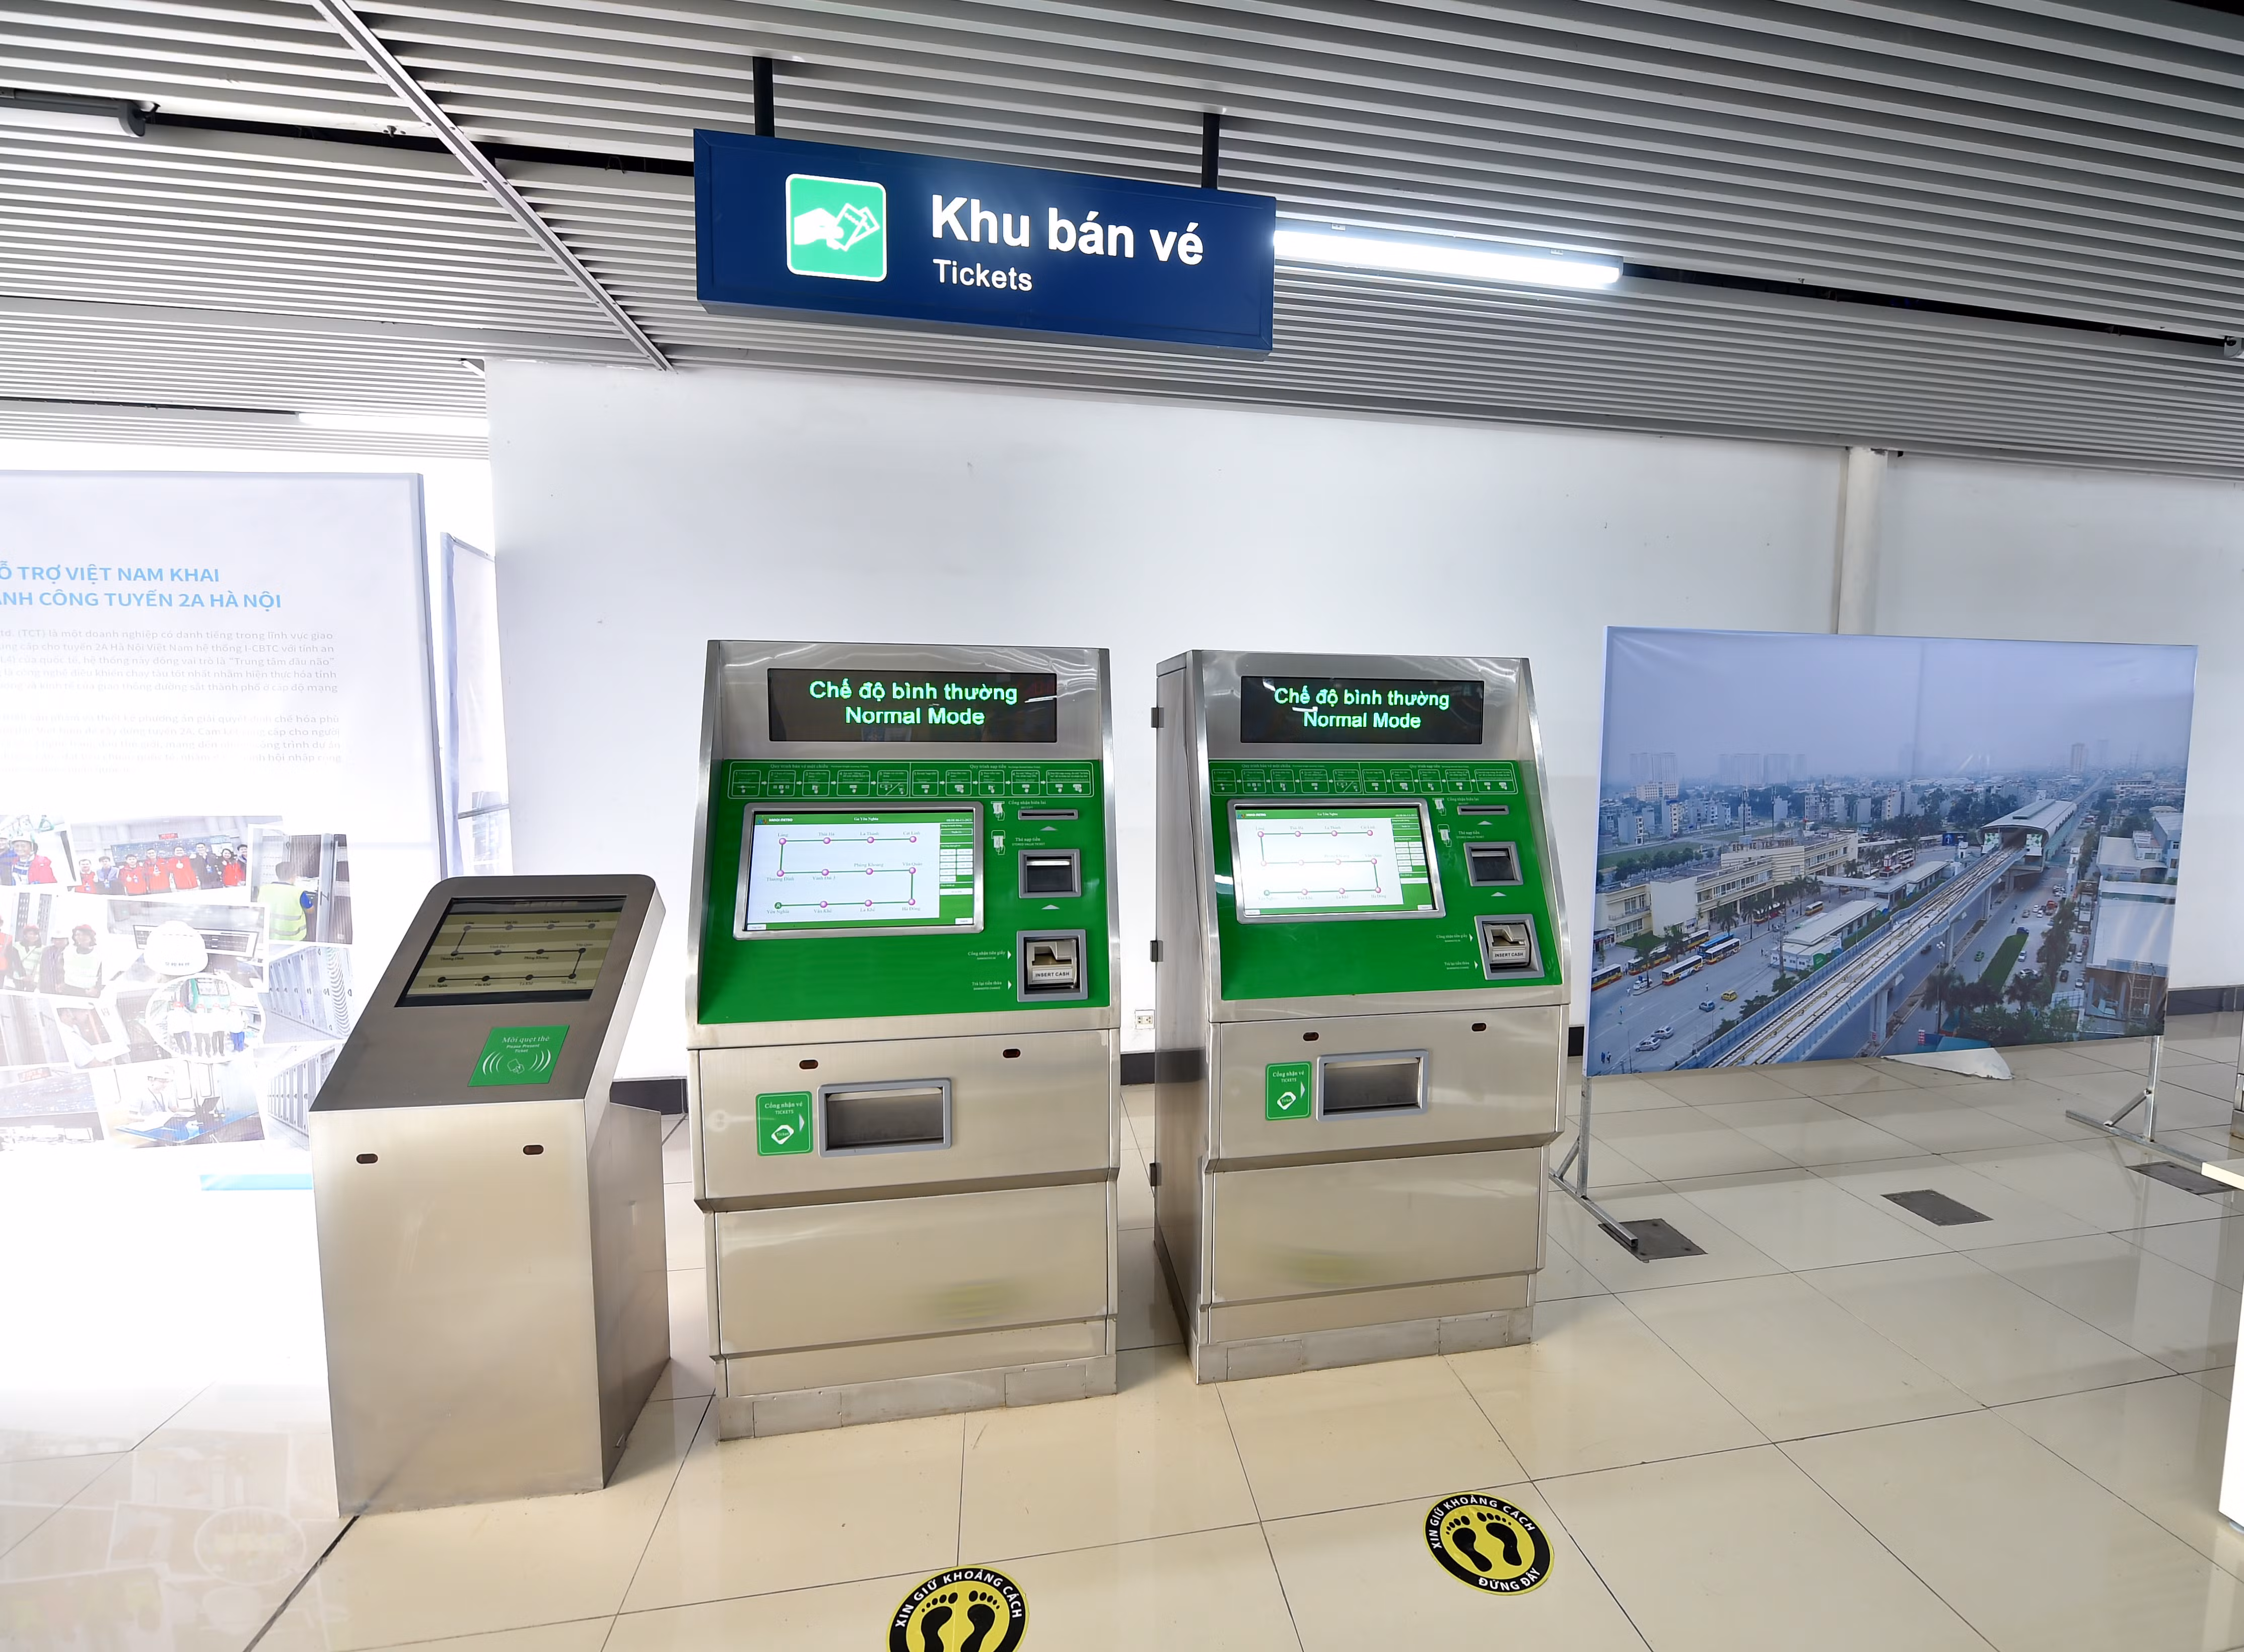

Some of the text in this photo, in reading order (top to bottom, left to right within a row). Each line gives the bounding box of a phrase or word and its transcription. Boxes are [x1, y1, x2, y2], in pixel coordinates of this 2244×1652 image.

[933, 194, 1204, 265] Khu bán vé
[933, 259, 1032, 292] Tickets
[17, 564, 60, 584] TRỢ
[65, 564, 111, 584] VIỆT
[118, 568, 163, 581] NAM
[170, 569, 219, 582] KHAI
[0, 589, 281, 611] NH CÔNG TUYẾN 2A HÀ NỘI
[809, 677, 1018, 705] Chế độ bình thường
[1274, 684, 1450, 710] Chế độ bình thường
[846, 706, 985, 725] Normal Mode
[1303, 711, 1421, 729] Normal Mode
[1429, 1495, 1535, 1549] XIN GIỮ KHOẢNG CÁCH
[1479, 1567, 1540, 1591] ĐỨNG ĐÂY
[895, 1569, 1022, 1627] XIN GIỮ KHOẢNG CÁCH
